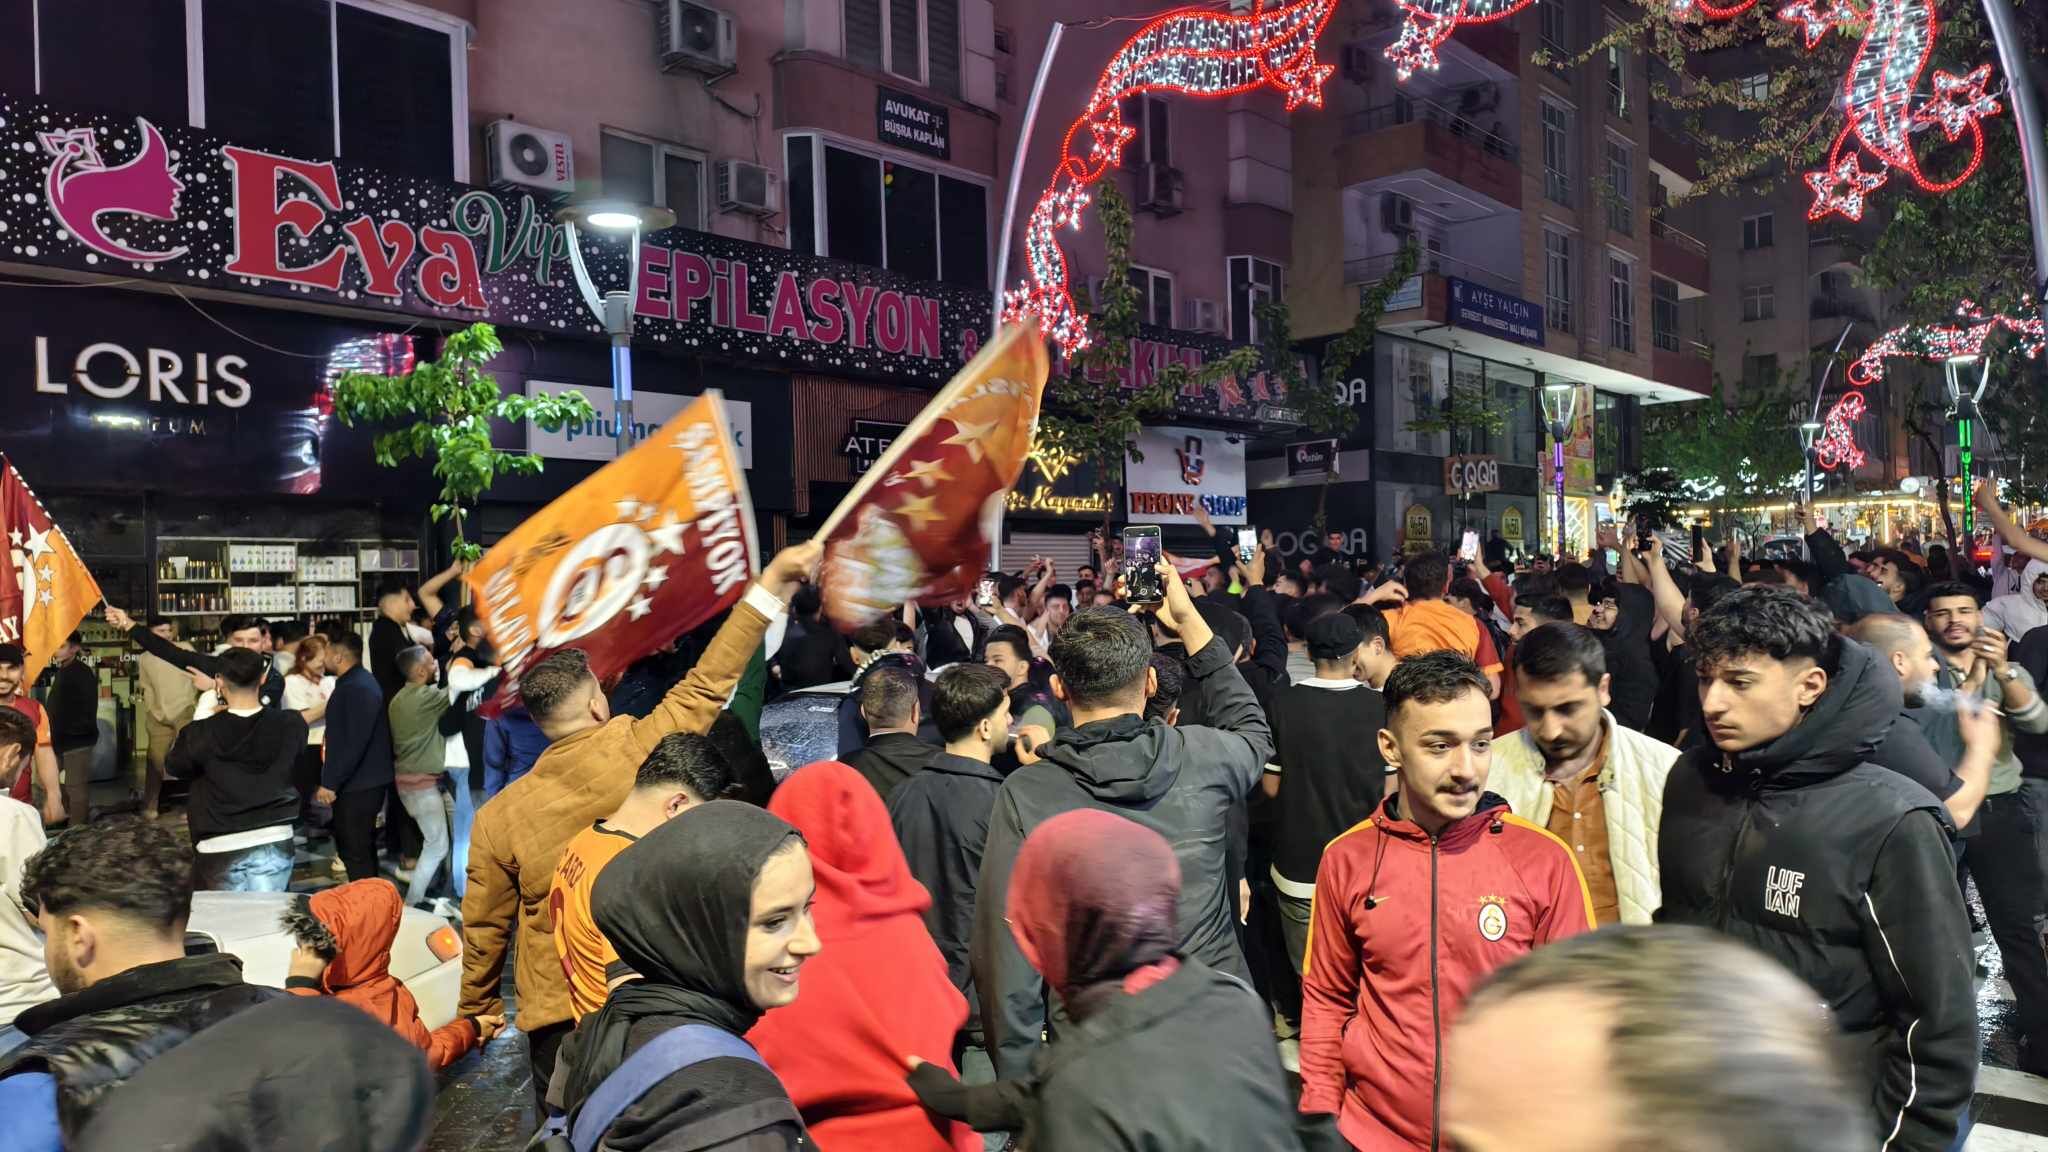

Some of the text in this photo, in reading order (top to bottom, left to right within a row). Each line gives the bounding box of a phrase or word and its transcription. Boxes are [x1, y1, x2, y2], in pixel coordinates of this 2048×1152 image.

[885, 100, 930, 124] AVUKAT
[914, 129, 945, 149] KAPLAN
[221, 144, 489, 310] Eva
[453, 190, 570, 286] Vip
[1471, 289, 1530, 319] AYŞE YALÇIN
[1130, 492, 1247, 516] PHONE SHOP
[1767, 865, 1805, 895] LUF
[1765, 887, 1801, 919] IAN
